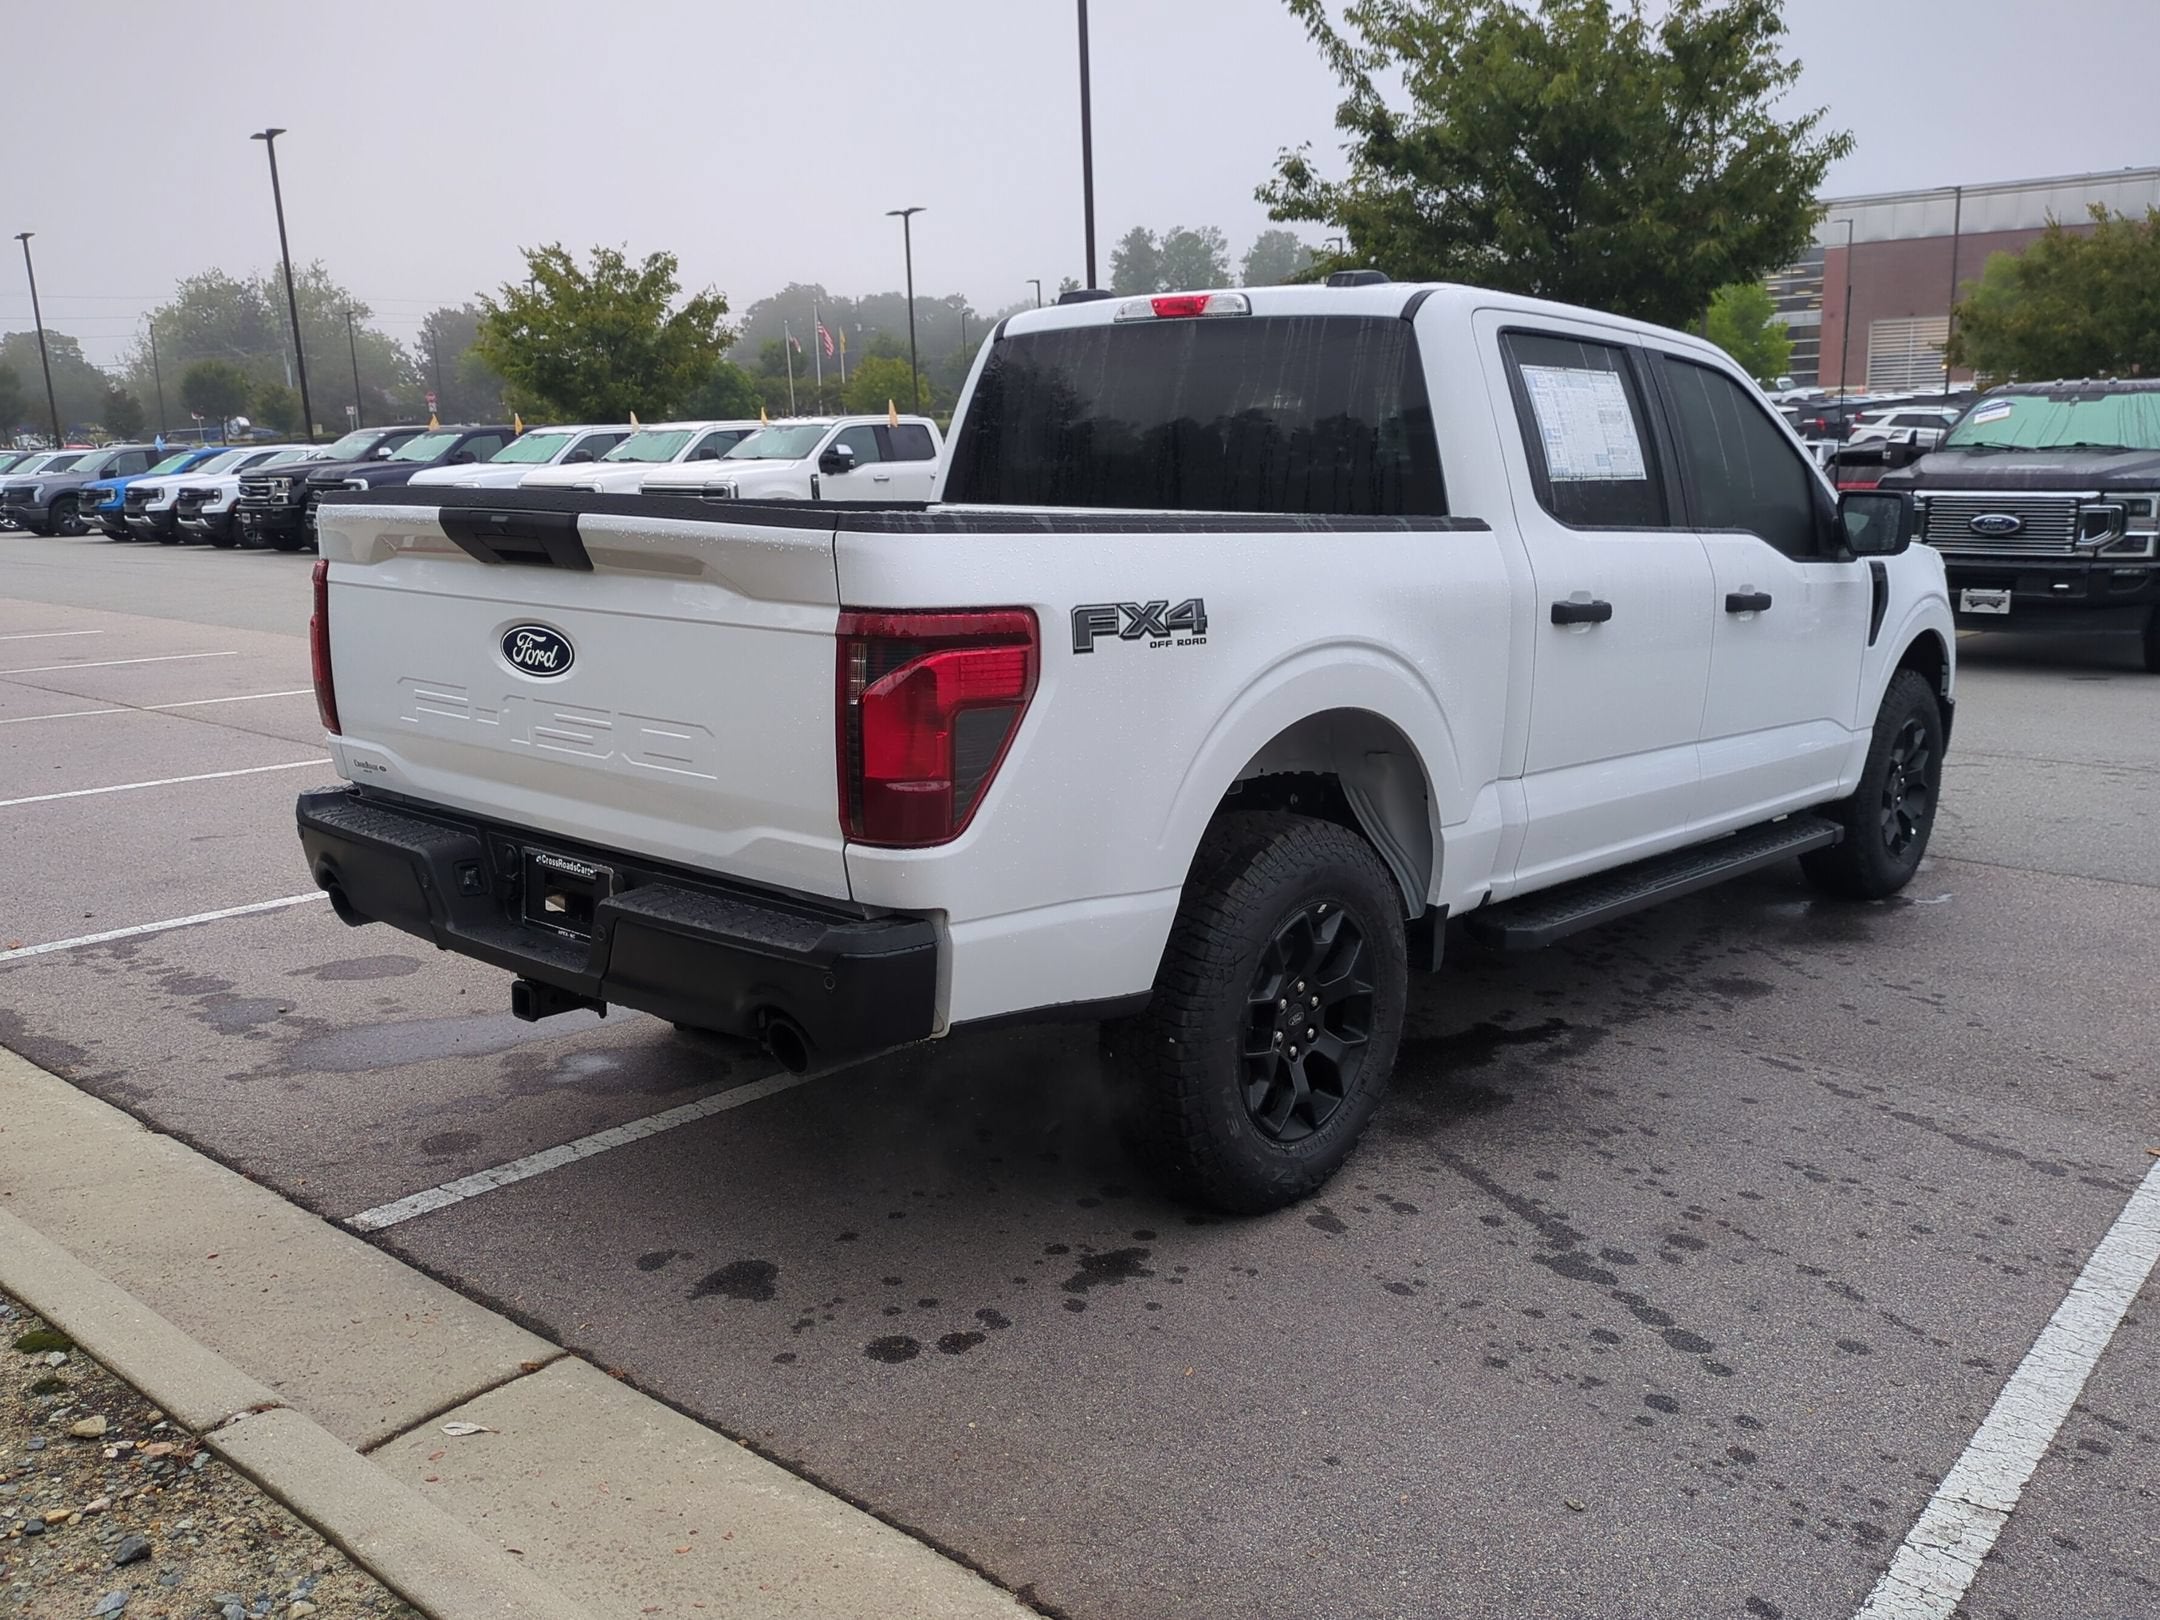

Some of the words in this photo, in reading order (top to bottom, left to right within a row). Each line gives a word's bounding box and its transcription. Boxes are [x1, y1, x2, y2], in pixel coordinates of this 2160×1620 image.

[1071, 598, 1208, 655] FX4
[1150, 640, 1173, 649] OFF
[1177, 637, 1207, 647] ROAD
[513, 631, 559, 668] Ford
